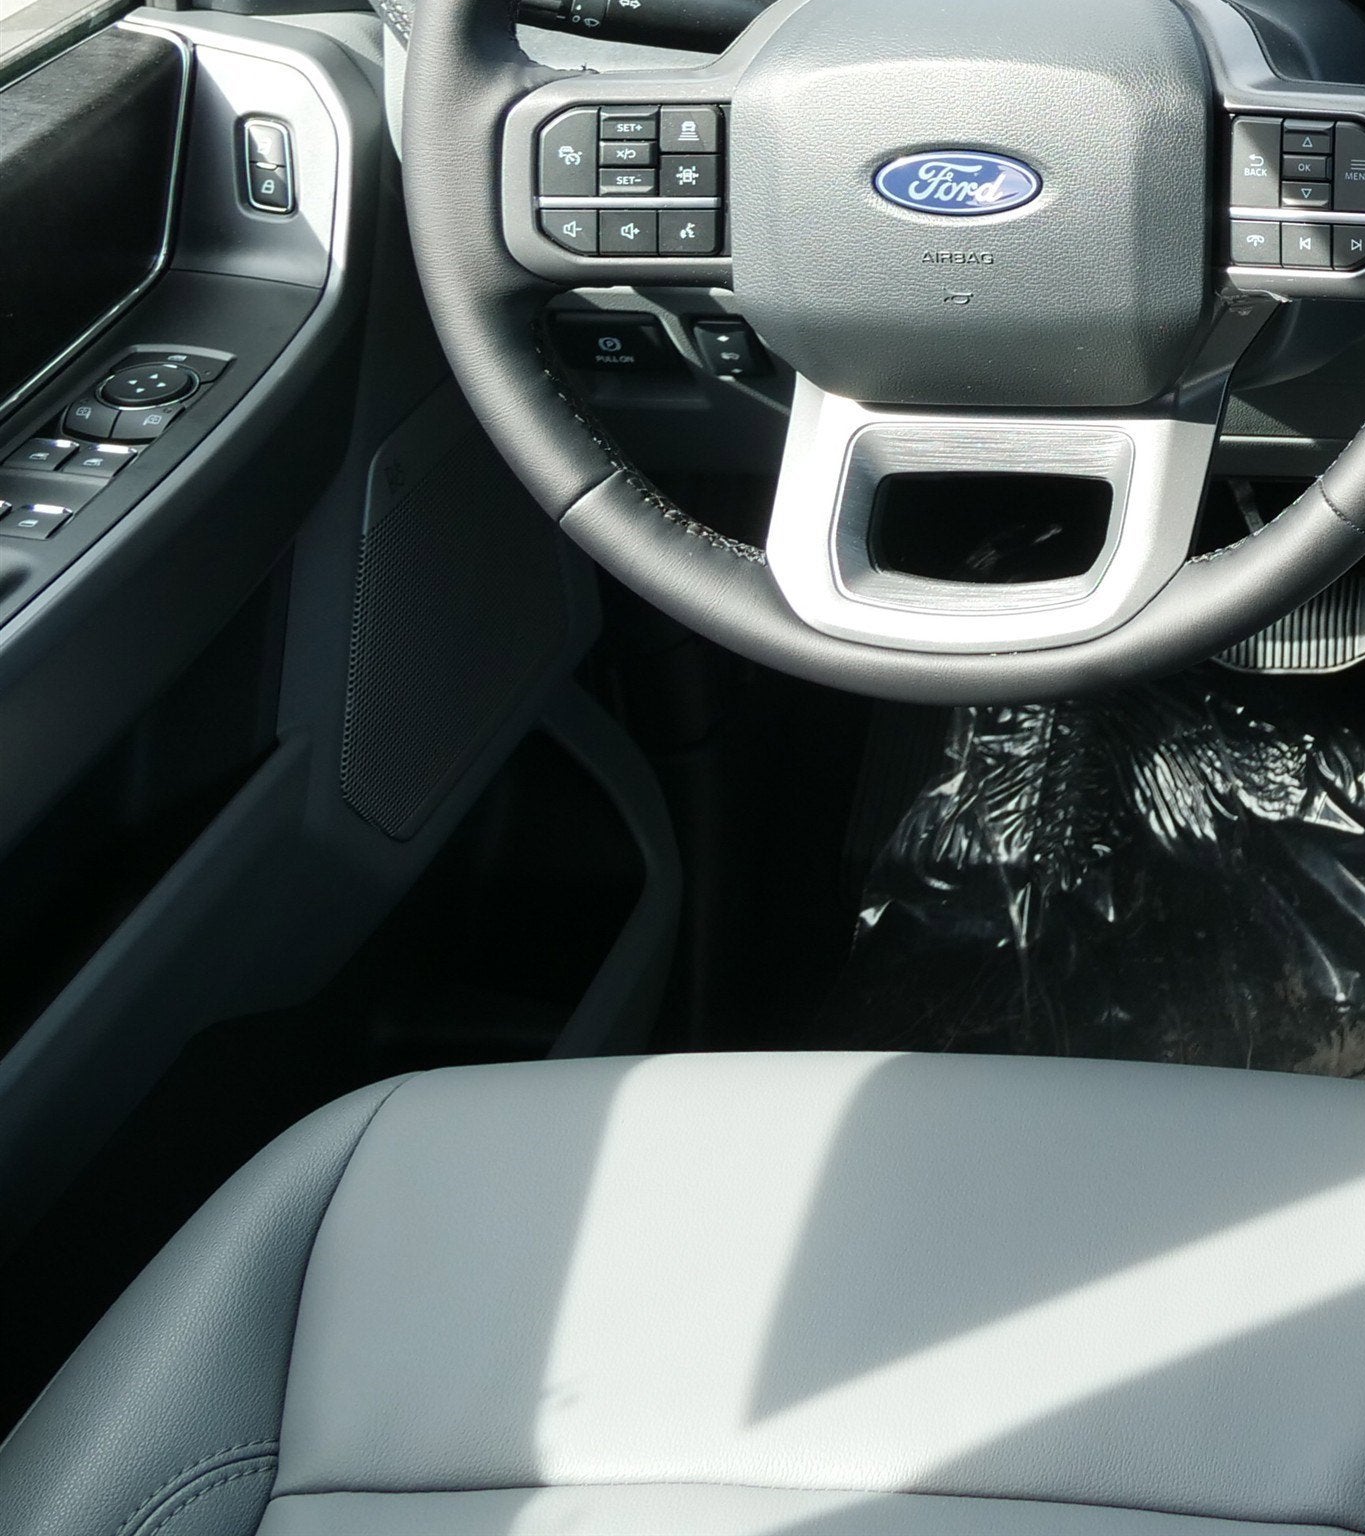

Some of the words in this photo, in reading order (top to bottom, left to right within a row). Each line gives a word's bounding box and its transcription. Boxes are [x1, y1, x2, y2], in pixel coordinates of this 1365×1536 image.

[616, 124, 643, 133] SET+
[1244, 168, 1267, 177] BACK
[1298, 164, 1311, 172] OK
[908, 161, 1007, 202] Ford
[922, 251, 994, 265] AIRBAG
